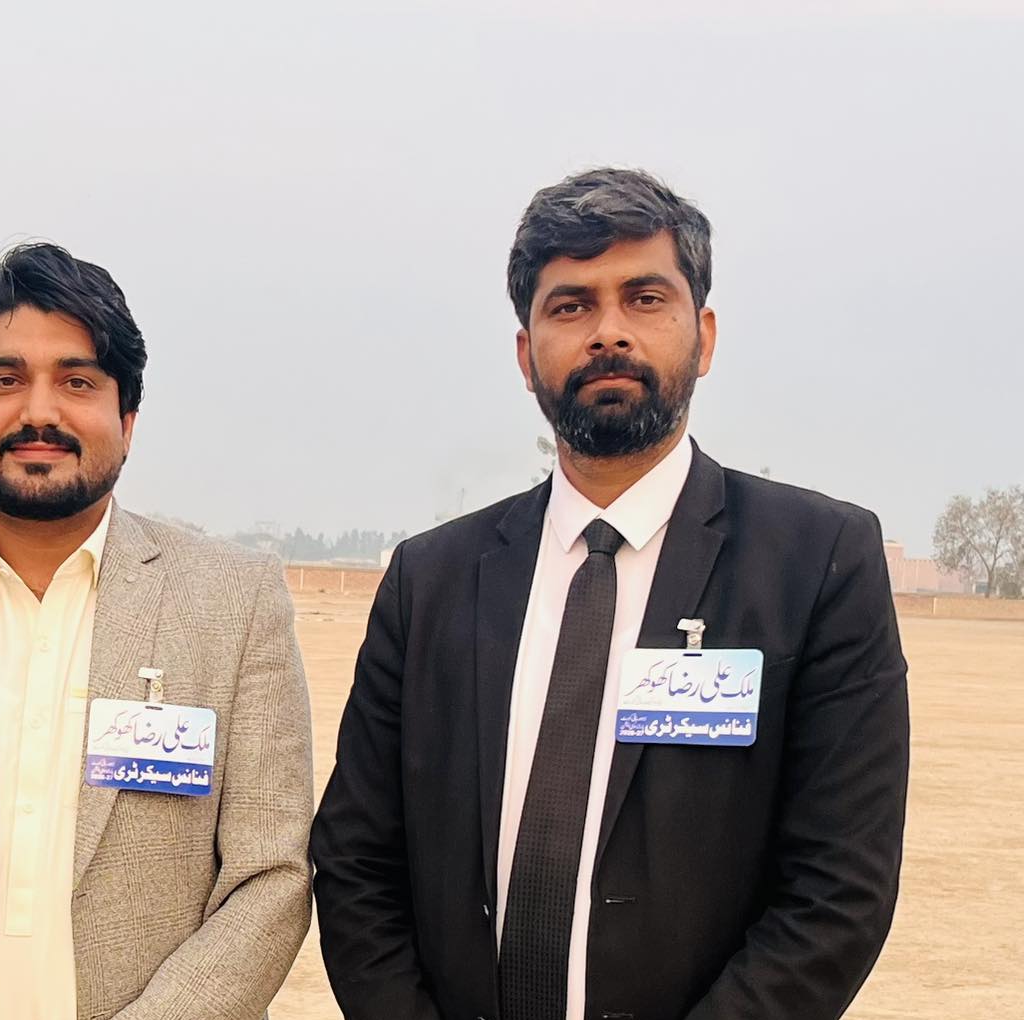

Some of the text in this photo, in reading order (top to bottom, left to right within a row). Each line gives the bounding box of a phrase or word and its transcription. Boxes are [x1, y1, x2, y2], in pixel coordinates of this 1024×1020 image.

[668, 669, 701, 698] رضا
[699, 660, 733, 704] علی
[721, 668, 756, 698] ملک
[133, 719, 163, 747] رضا
[162, 711, 190, 754] علی
[181, 726, 210, 751] ملک
[644, 714, 709, 738] سیکرٹری
[708, 717, 752, 739] فنانس
[113, 761, 173, 784] سیکرٹری
[171, 767, 210, 787] فنانس
